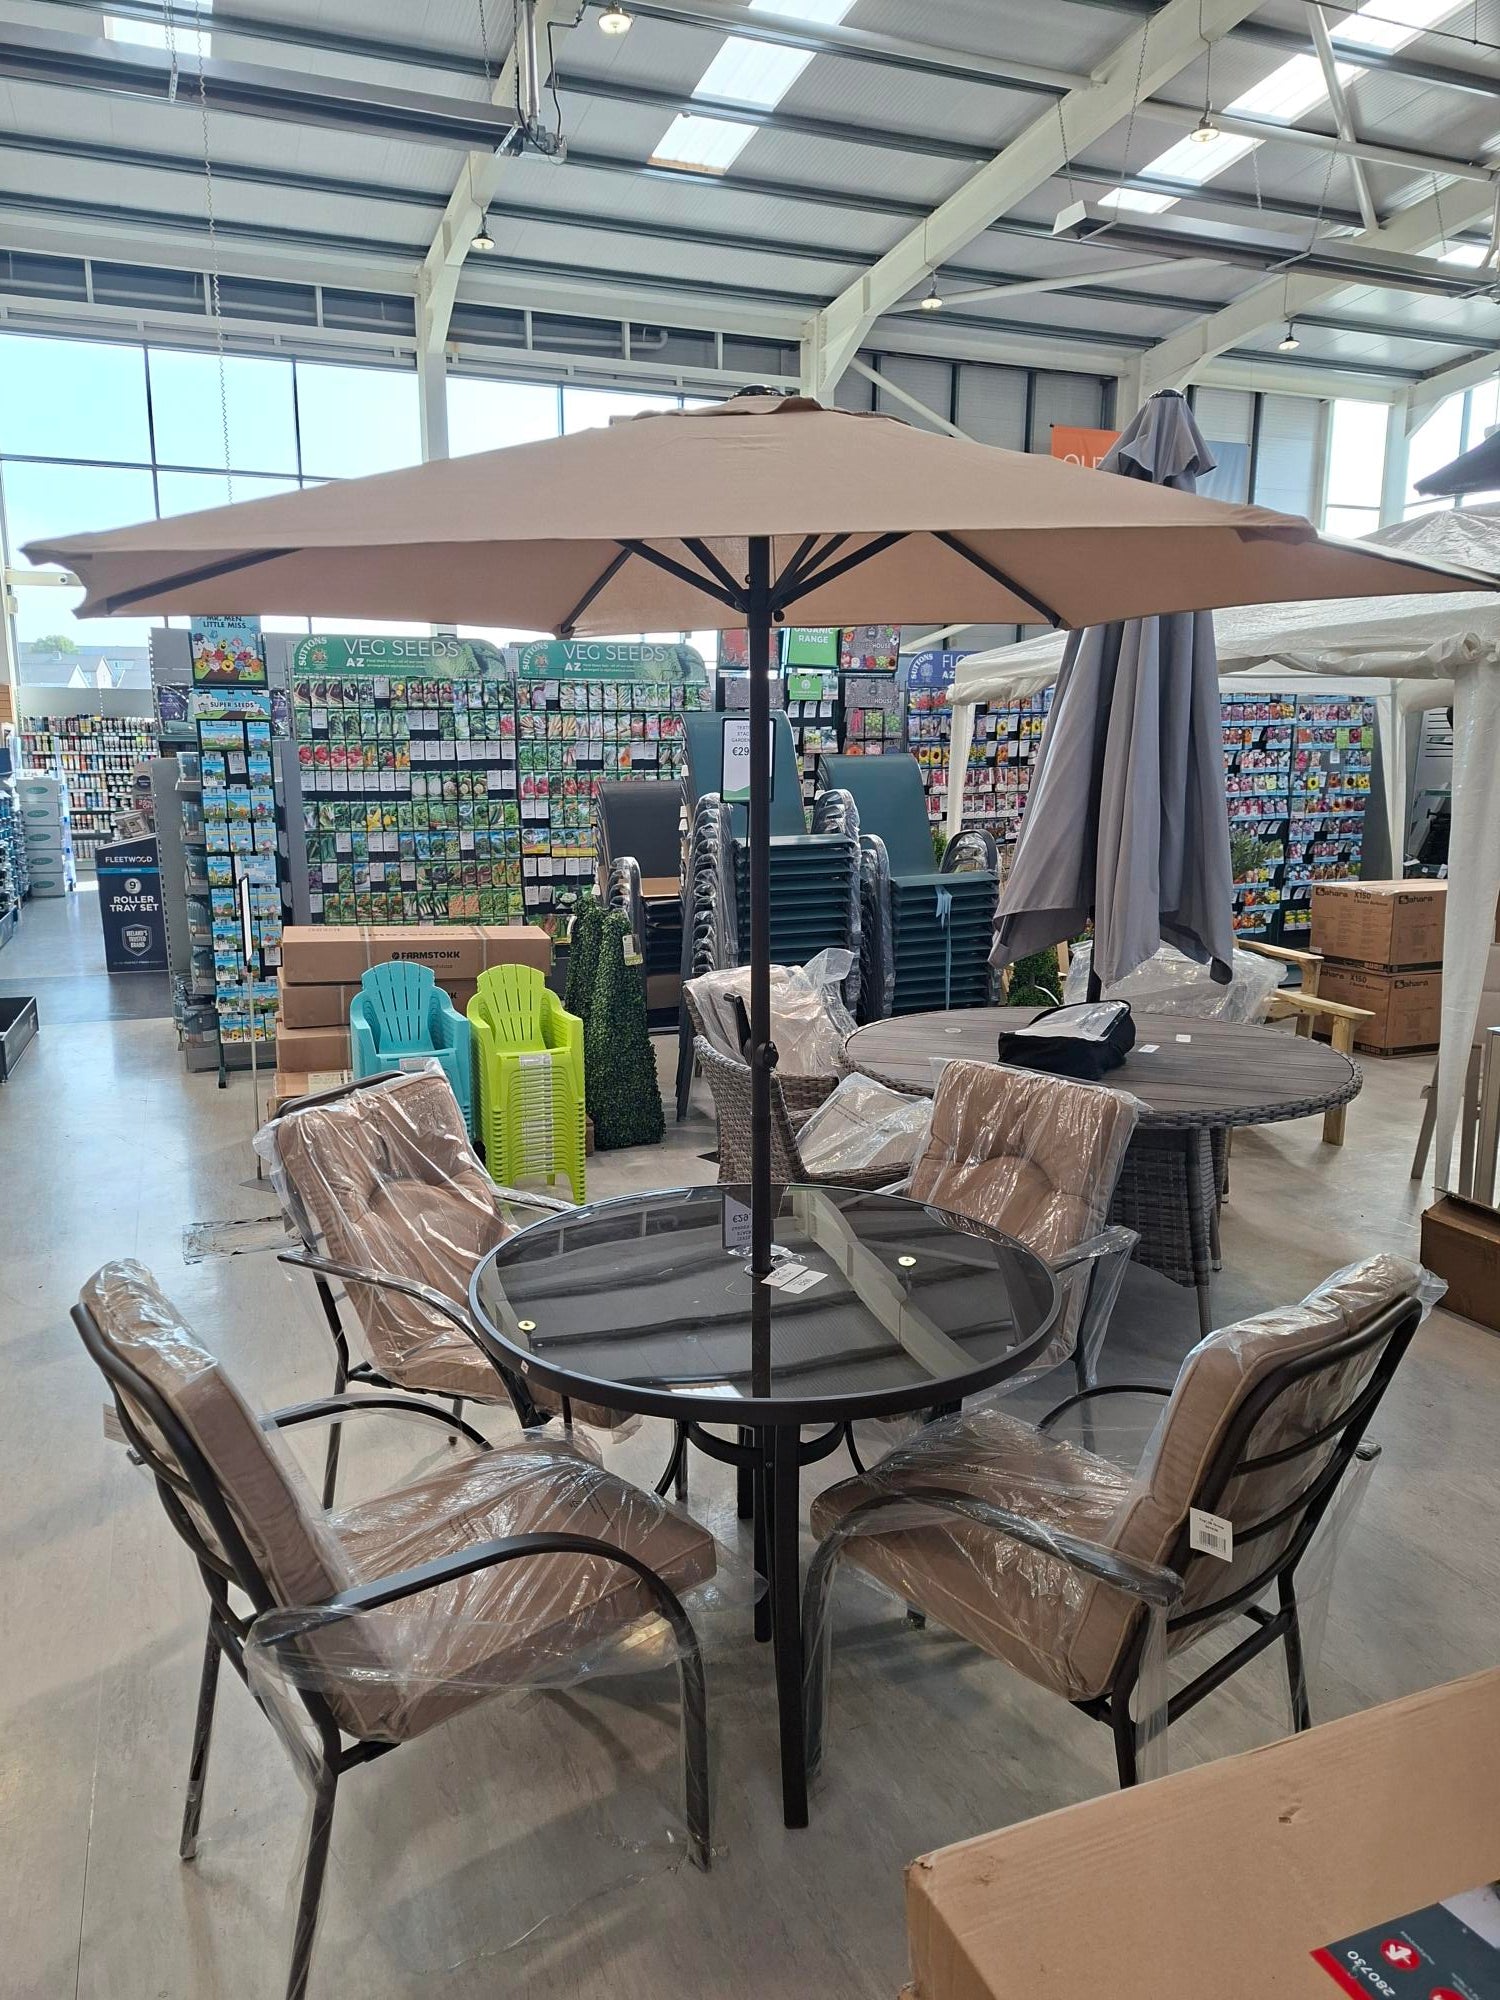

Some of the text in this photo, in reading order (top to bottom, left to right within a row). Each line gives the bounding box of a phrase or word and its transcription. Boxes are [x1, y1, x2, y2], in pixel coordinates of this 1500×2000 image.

[798, 634, 829, 644] RANGE
[298, 636, 328, 667] SUTTONS
[343, 638, 459, 657] VEG SEEDS
[563, 644, 665, 661] VEG SEEDS
[522, 642, 549, 671] SUTTONS
[346, 657, 365, 667] AZ
[564, 662, 582, 672] AZ
[910, 653, 934, 680] SUTTONS
[105, 855, 153, 863] FLEETWOOD
[113, 895, 154, 904] ROLLER
[110, 903, 159, 912] TRAY SET
[401, 951, 460, 960] FARMSTOKK
[1346, 1950, 1396, 1997] 280730
